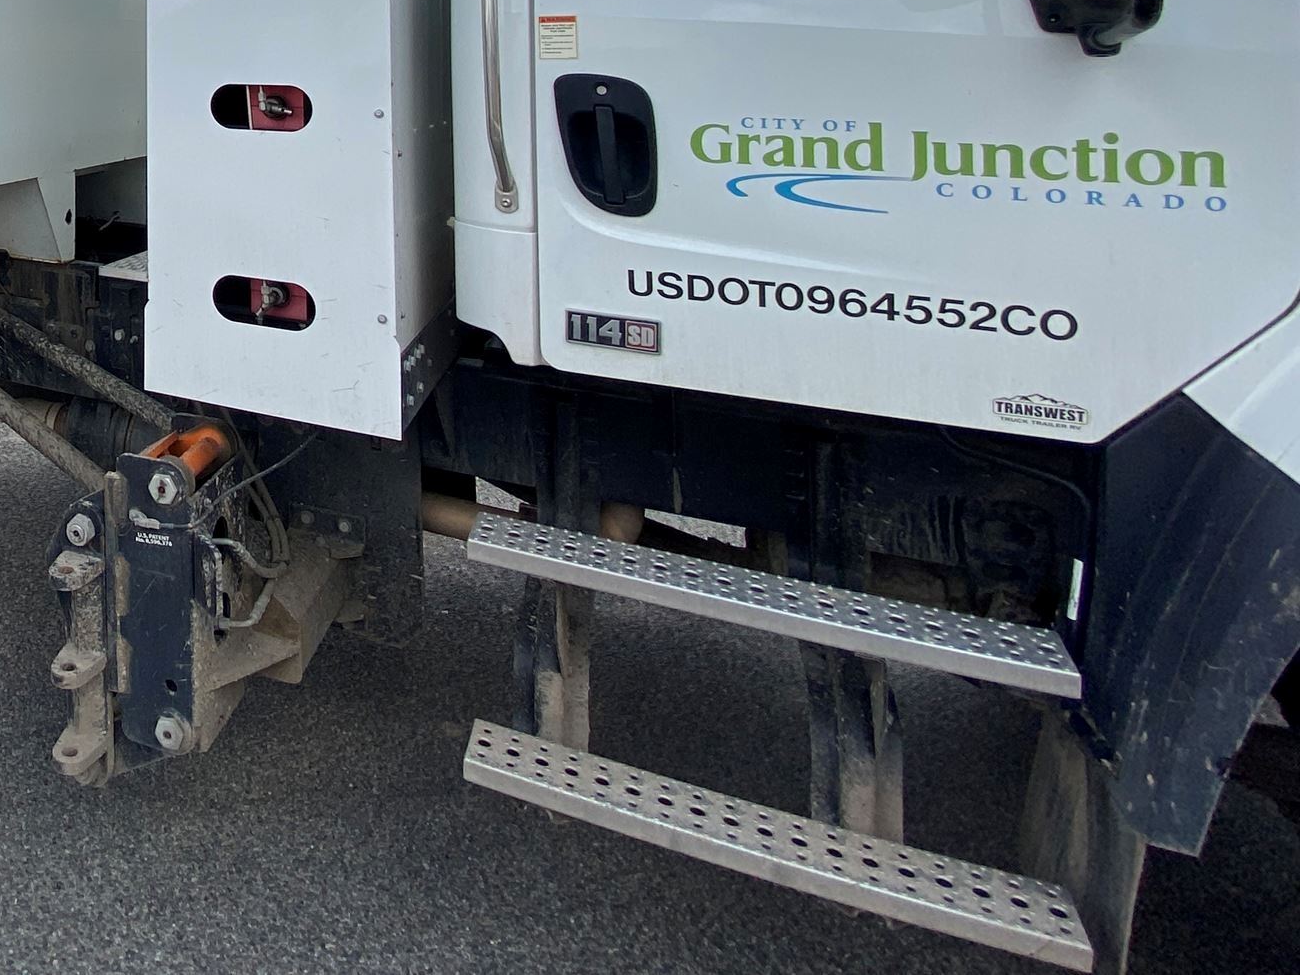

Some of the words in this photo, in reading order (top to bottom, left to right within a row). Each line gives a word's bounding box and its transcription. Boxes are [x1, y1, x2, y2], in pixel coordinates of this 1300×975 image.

[740, 117, 805, 130] CITY
[822, 119, 857, 132] OF
[689, 121, 885, 172] Grand
[910, 130, 1228, 188] Junction
[935, 182, 1228, 212] COLORADO
[627, 269, 1079, 341] USDOT0964552CO
[570, 313, 622, 346] 114
[995, 400, 1085, 423] TRANSWEST
[1000, 416, 1029, 425] TRUCK
[1031, 419, 1067, 430] TRAILER
[148, 533, 170, 541] PATENT
